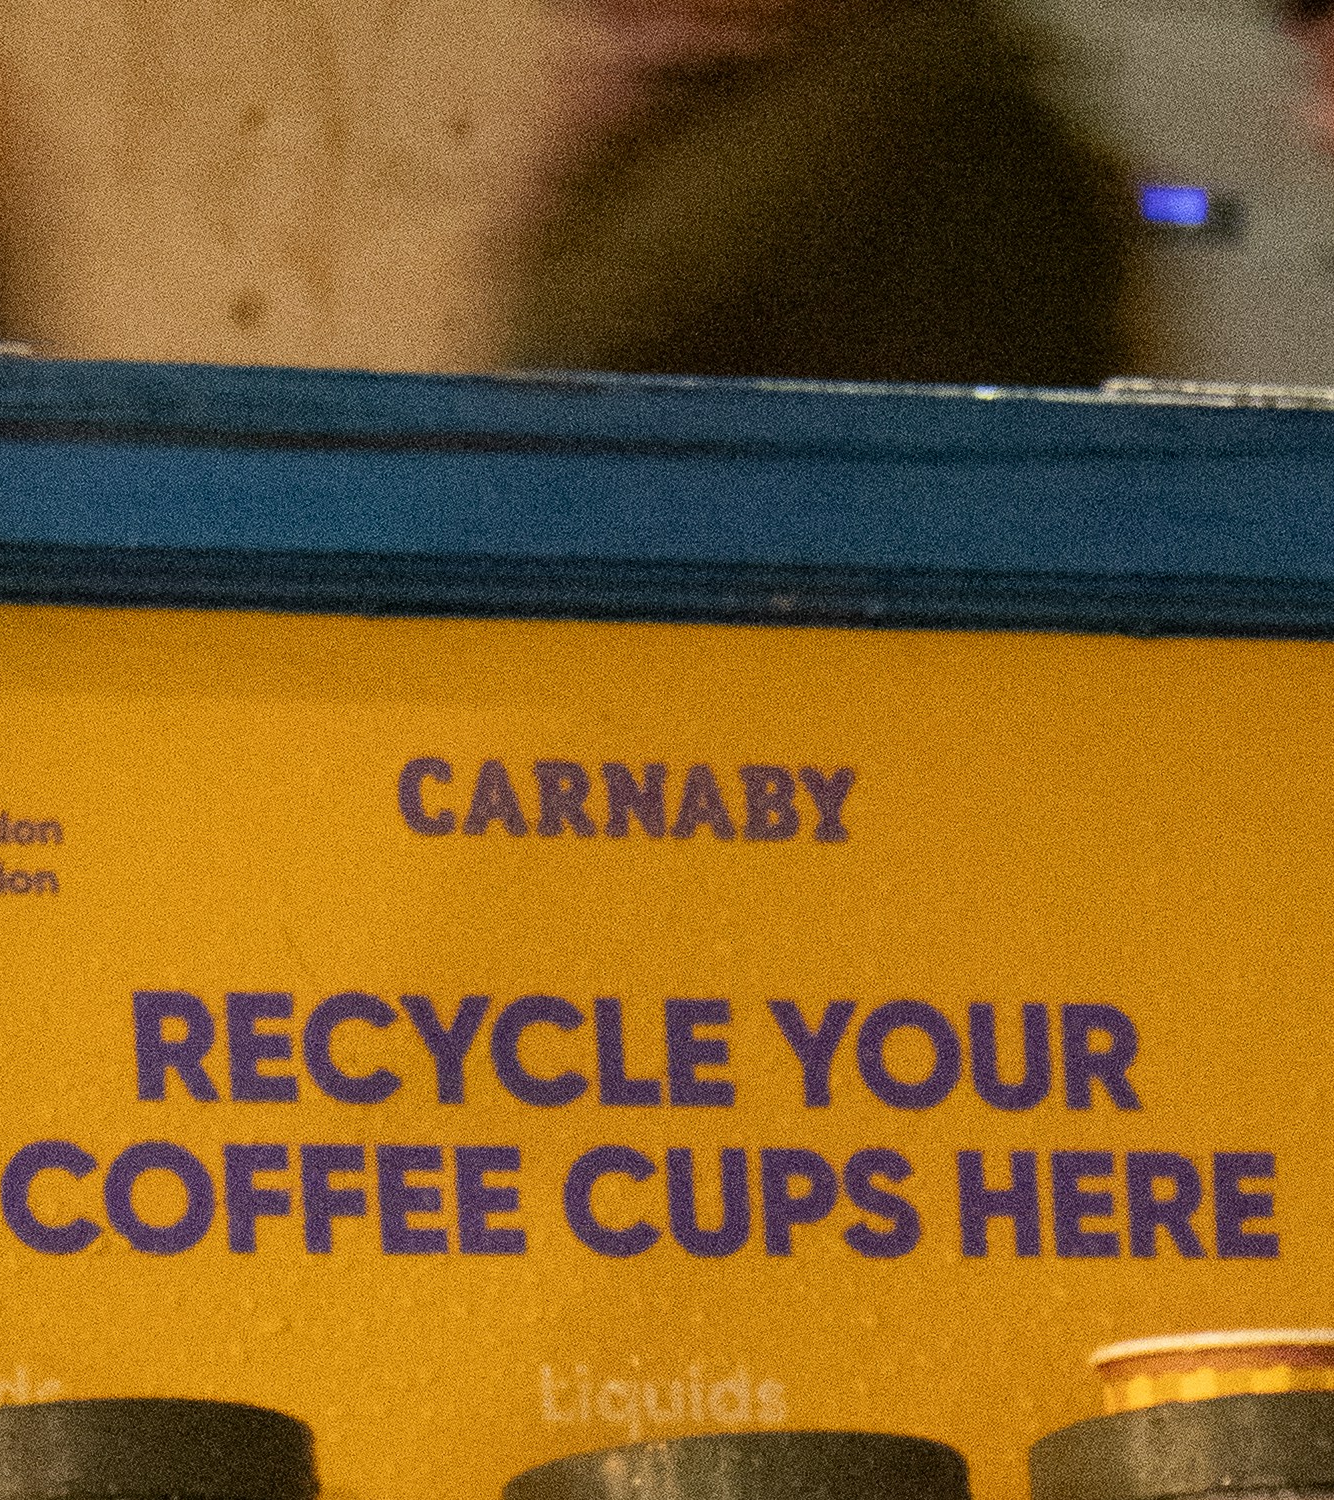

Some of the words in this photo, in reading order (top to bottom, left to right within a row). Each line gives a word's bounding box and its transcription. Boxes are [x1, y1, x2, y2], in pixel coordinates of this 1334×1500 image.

[398, 757, 856, 844] CARNABY
[133, 991, 736, 1108] RECYCLE
[768, 999, 1141, 1112] YOUR
[0, 1140, 527, 1255] COFFEE
[563, 1145, 922, 1259] CUPS
[957, 1150, 1279, 1259] HERE
[538, 1361, 789, 1440] Liquids
